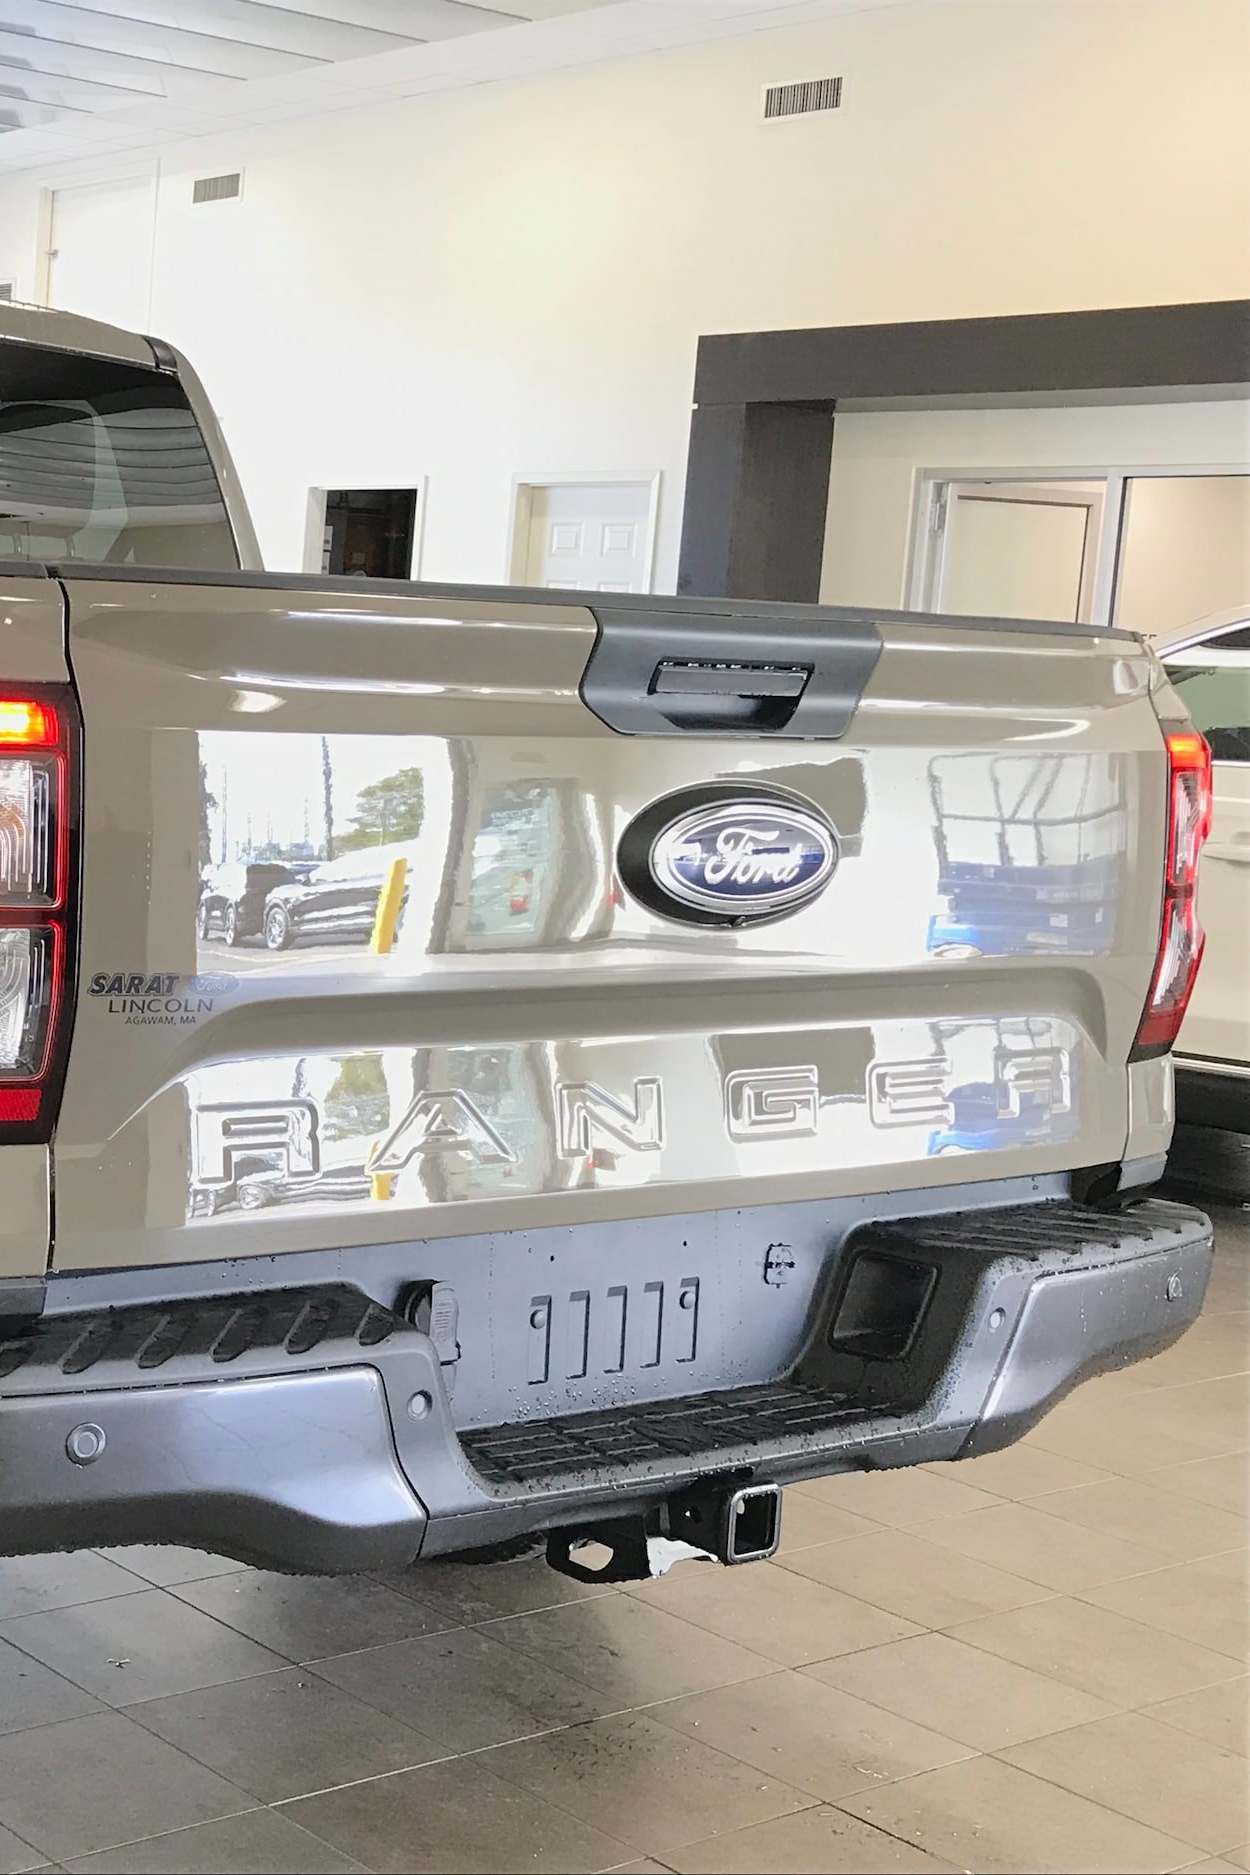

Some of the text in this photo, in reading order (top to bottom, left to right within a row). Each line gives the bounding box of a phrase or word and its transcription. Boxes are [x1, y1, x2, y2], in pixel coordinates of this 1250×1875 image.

[704, 827, 803, 885] Ford
[88, 972, 180, 996] SARAT
[108, 998, 214, 1013] LINCOLN
[125, 1015, 197, 1026] AGAWAM, MA
[193, 1046, 1071, 1183] RANGER
